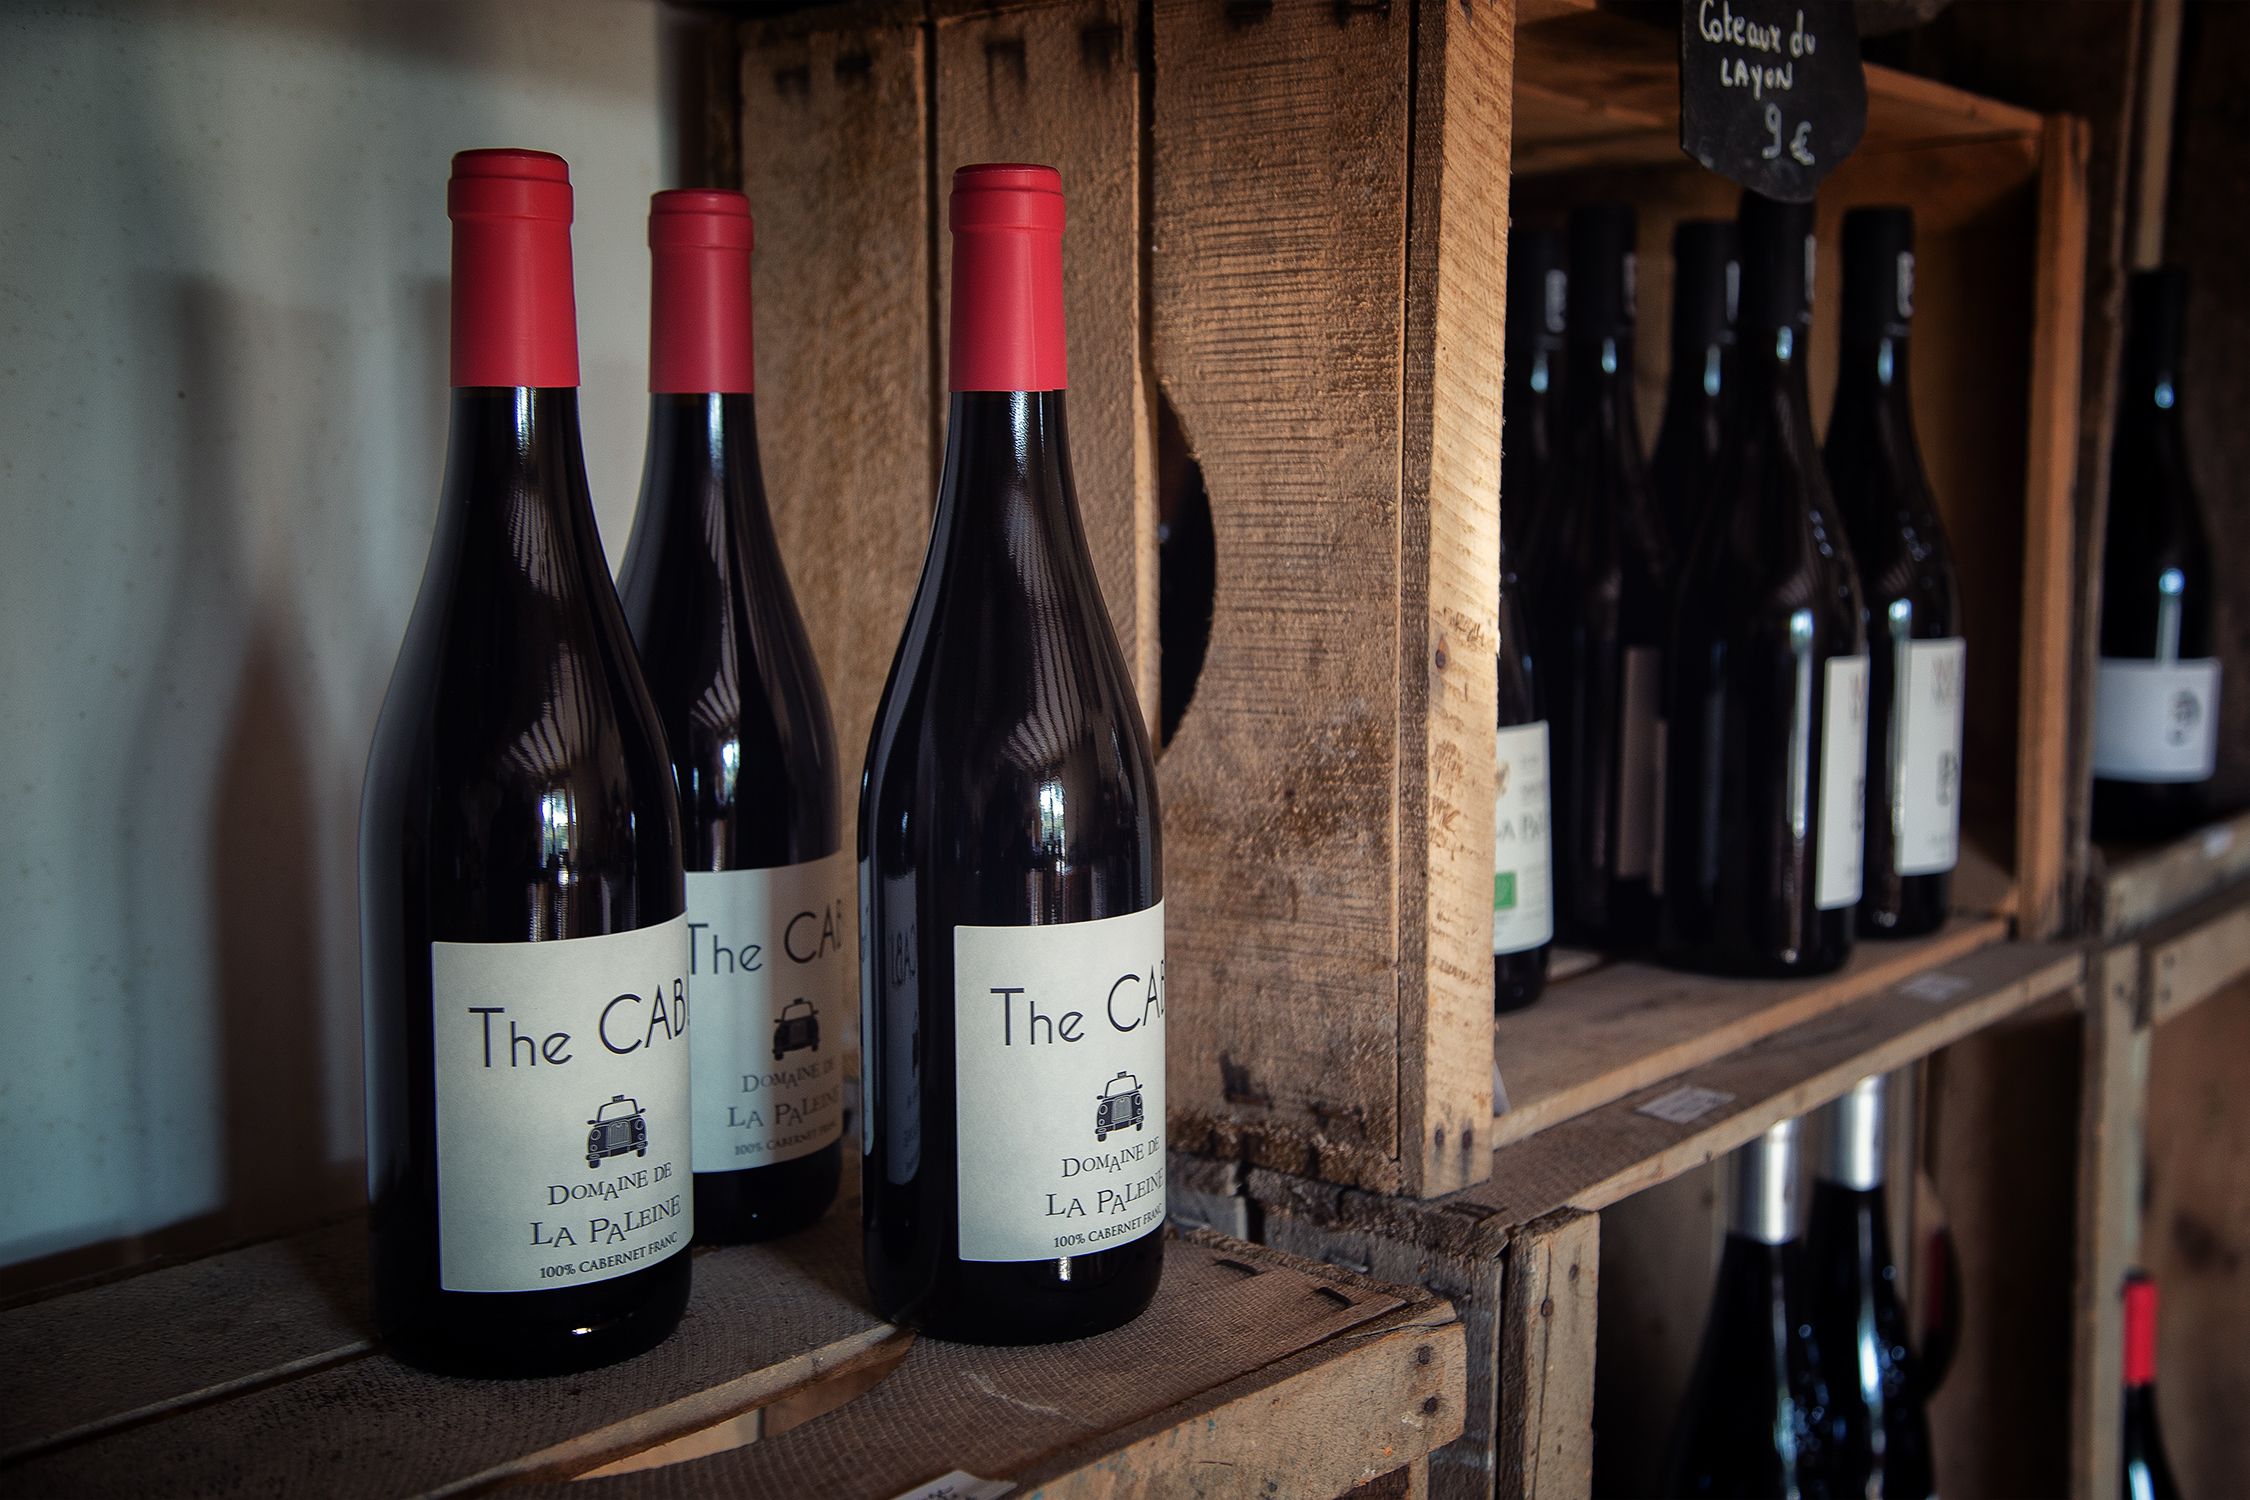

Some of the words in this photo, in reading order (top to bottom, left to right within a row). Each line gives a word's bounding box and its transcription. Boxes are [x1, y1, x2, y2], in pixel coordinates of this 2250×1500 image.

[1699, 0, 1781, 53] Coteaux
[1788, 9, 1816, 58] du
[1762, 103, 1782, 159] 9
[688, 922, 763, 975] The
[468, 1006, 573, 1068] The
[990, 986, 1085, 1046] The
[727, 1105, 764, 1130] LA
[1061, 1143, 1144, 1178] DOMAINE
[1148, 1135, 1160, 1156] DE
[547, 1169, 649, 1206] DOMAINE
[653, 1161, 673, 1183] DE
[1045, 1193, 1087, 1218] LA
[1097, 1167, 1163, 1215] PALEINE
[530, 1221, 577, 1248] LA
[589, 1194, 682, 1245] PALEINE
[1053, 1233, 1085, 1248] 100%
[1087, 1216, 1142, 1243] CABERNET
[539, 1264, 576, 1279] 100%
[579, 1246, 647, 1274] CABERNET
[648, 1231, 678, 1256] FRANC
